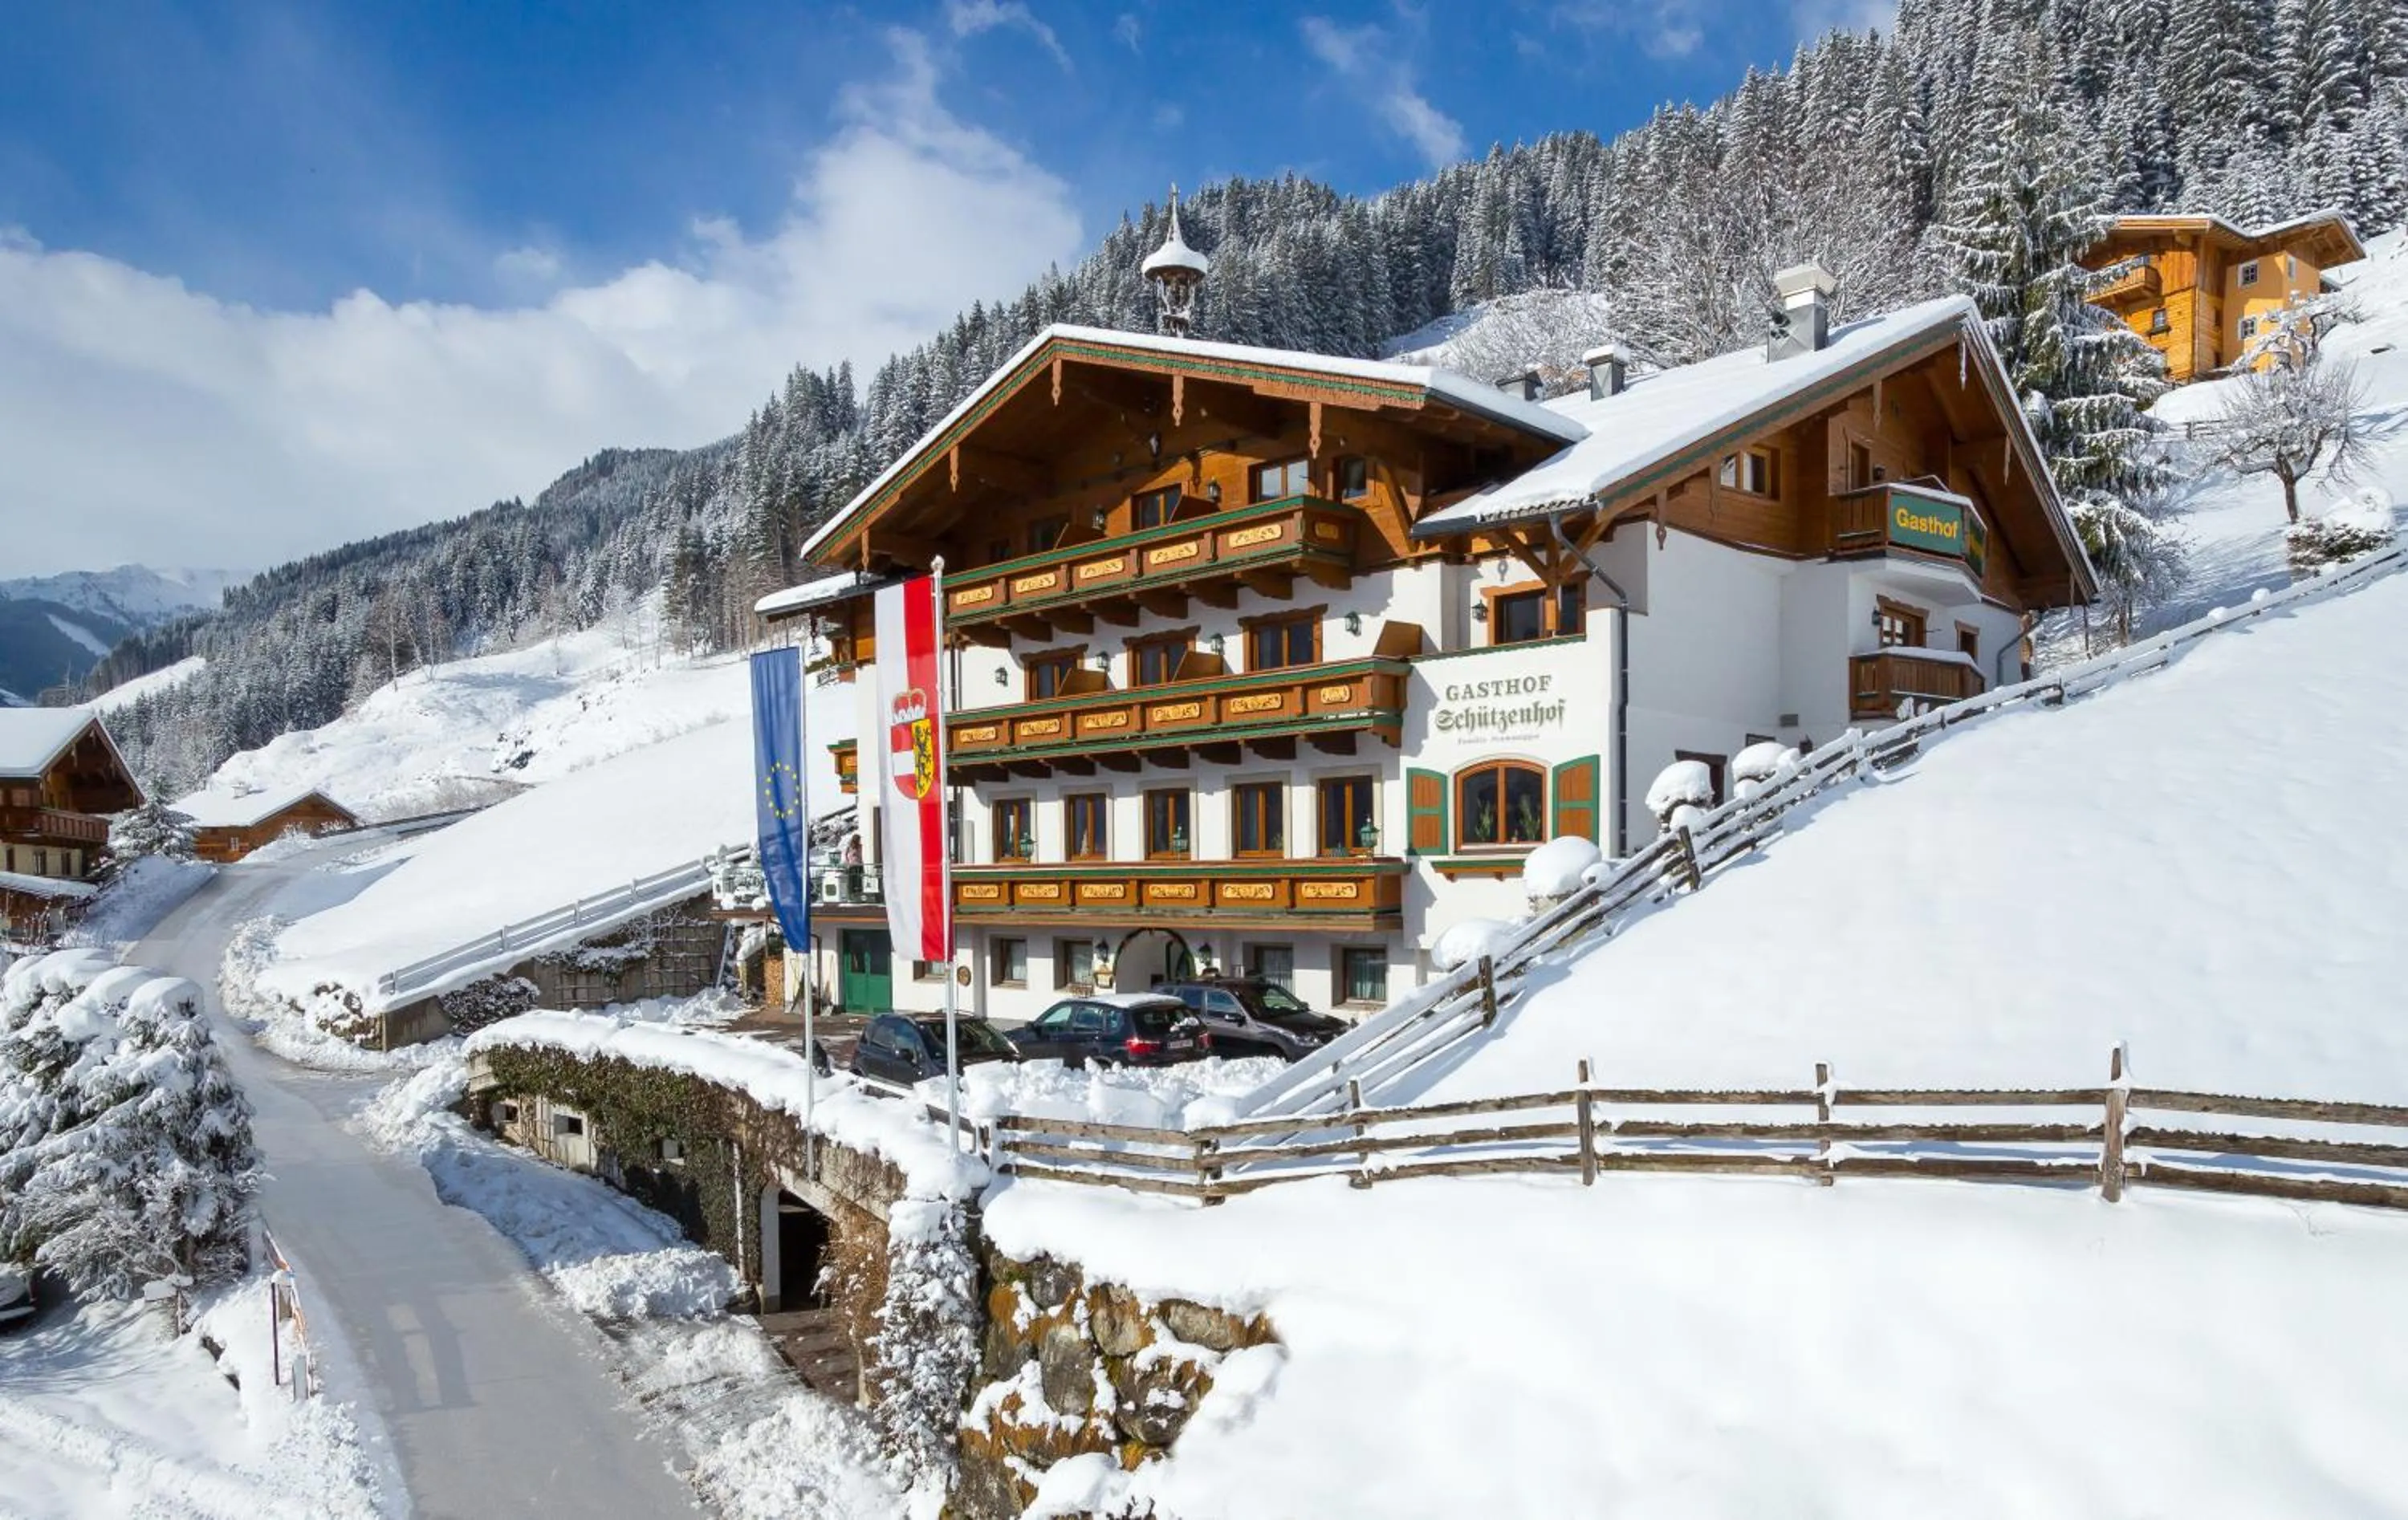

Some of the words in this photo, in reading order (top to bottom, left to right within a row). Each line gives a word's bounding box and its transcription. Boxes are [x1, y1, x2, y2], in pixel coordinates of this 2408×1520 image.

[1896, 508, 1958, 539] Gasthof
[1446, 675, 1552, 701] GASTHOF
[1435, 698, 1566, 732] Schützenhof
